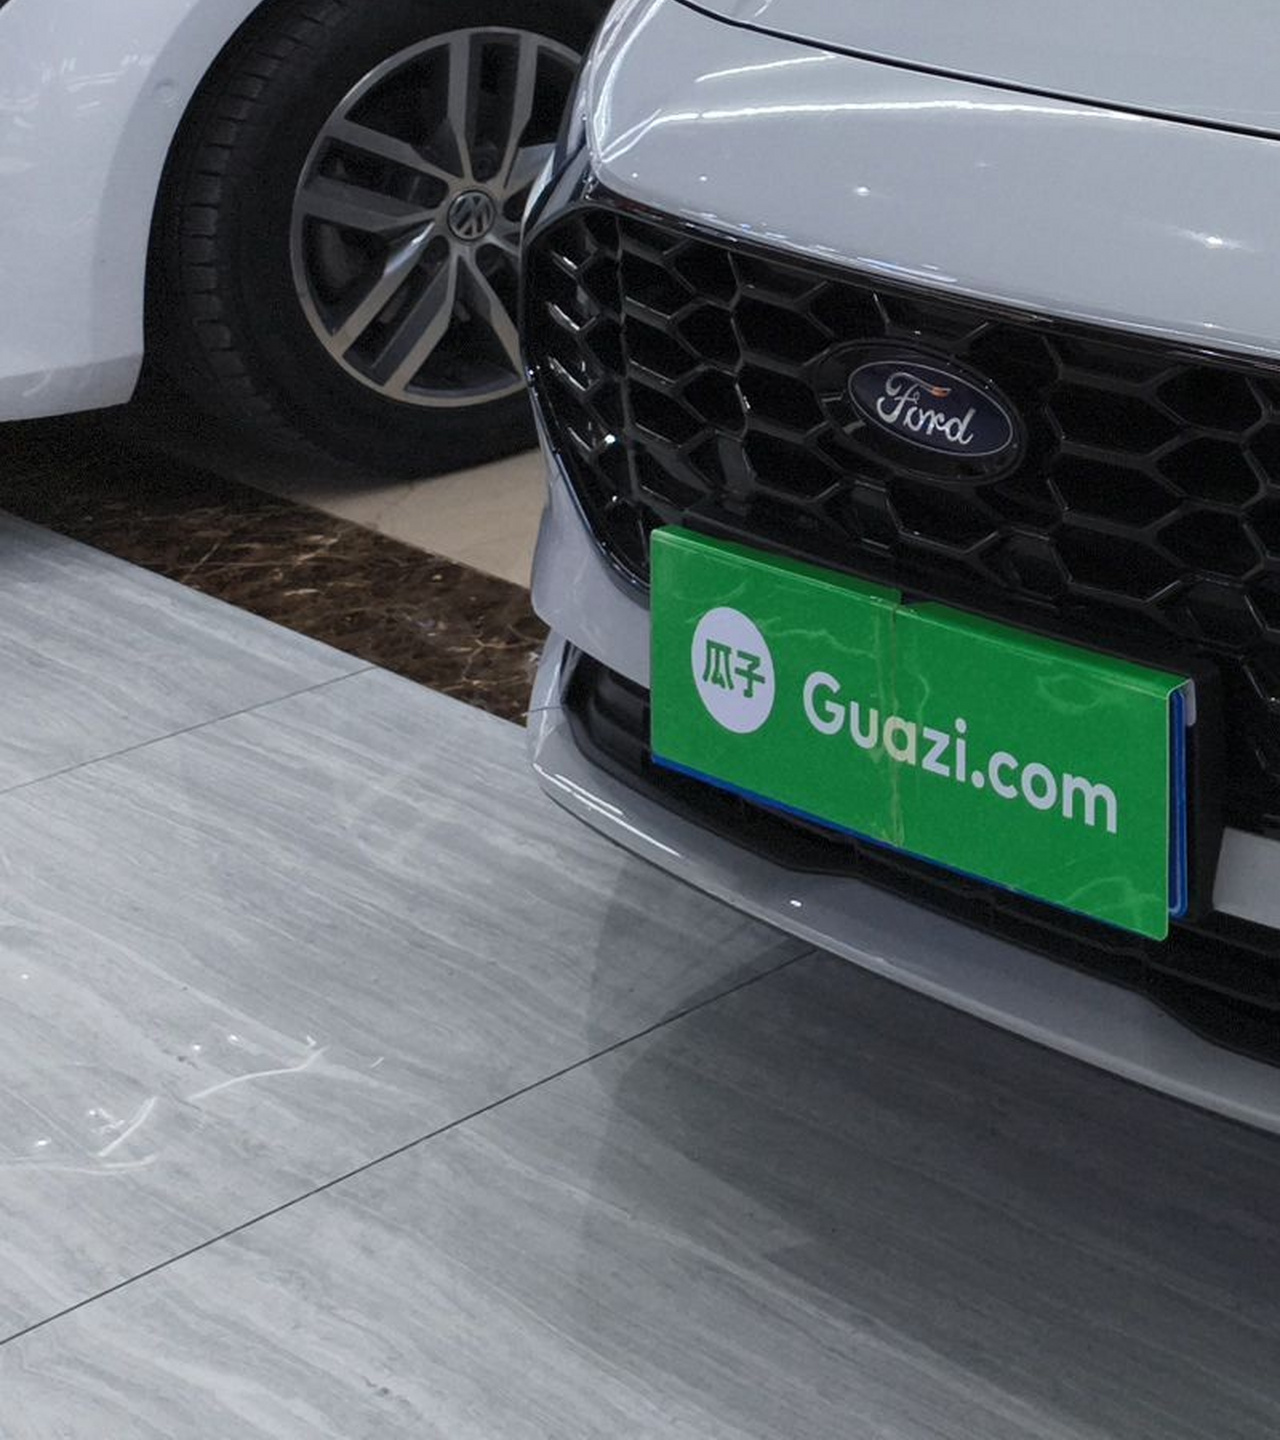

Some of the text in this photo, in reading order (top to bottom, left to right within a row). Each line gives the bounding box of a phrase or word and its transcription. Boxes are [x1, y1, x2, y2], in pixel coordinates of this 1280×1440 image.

[875, 371, 978, 447] Ford
[701, 638, 768, 700] 瓜子
[801, 670, 1119, 835] Guazi.com
